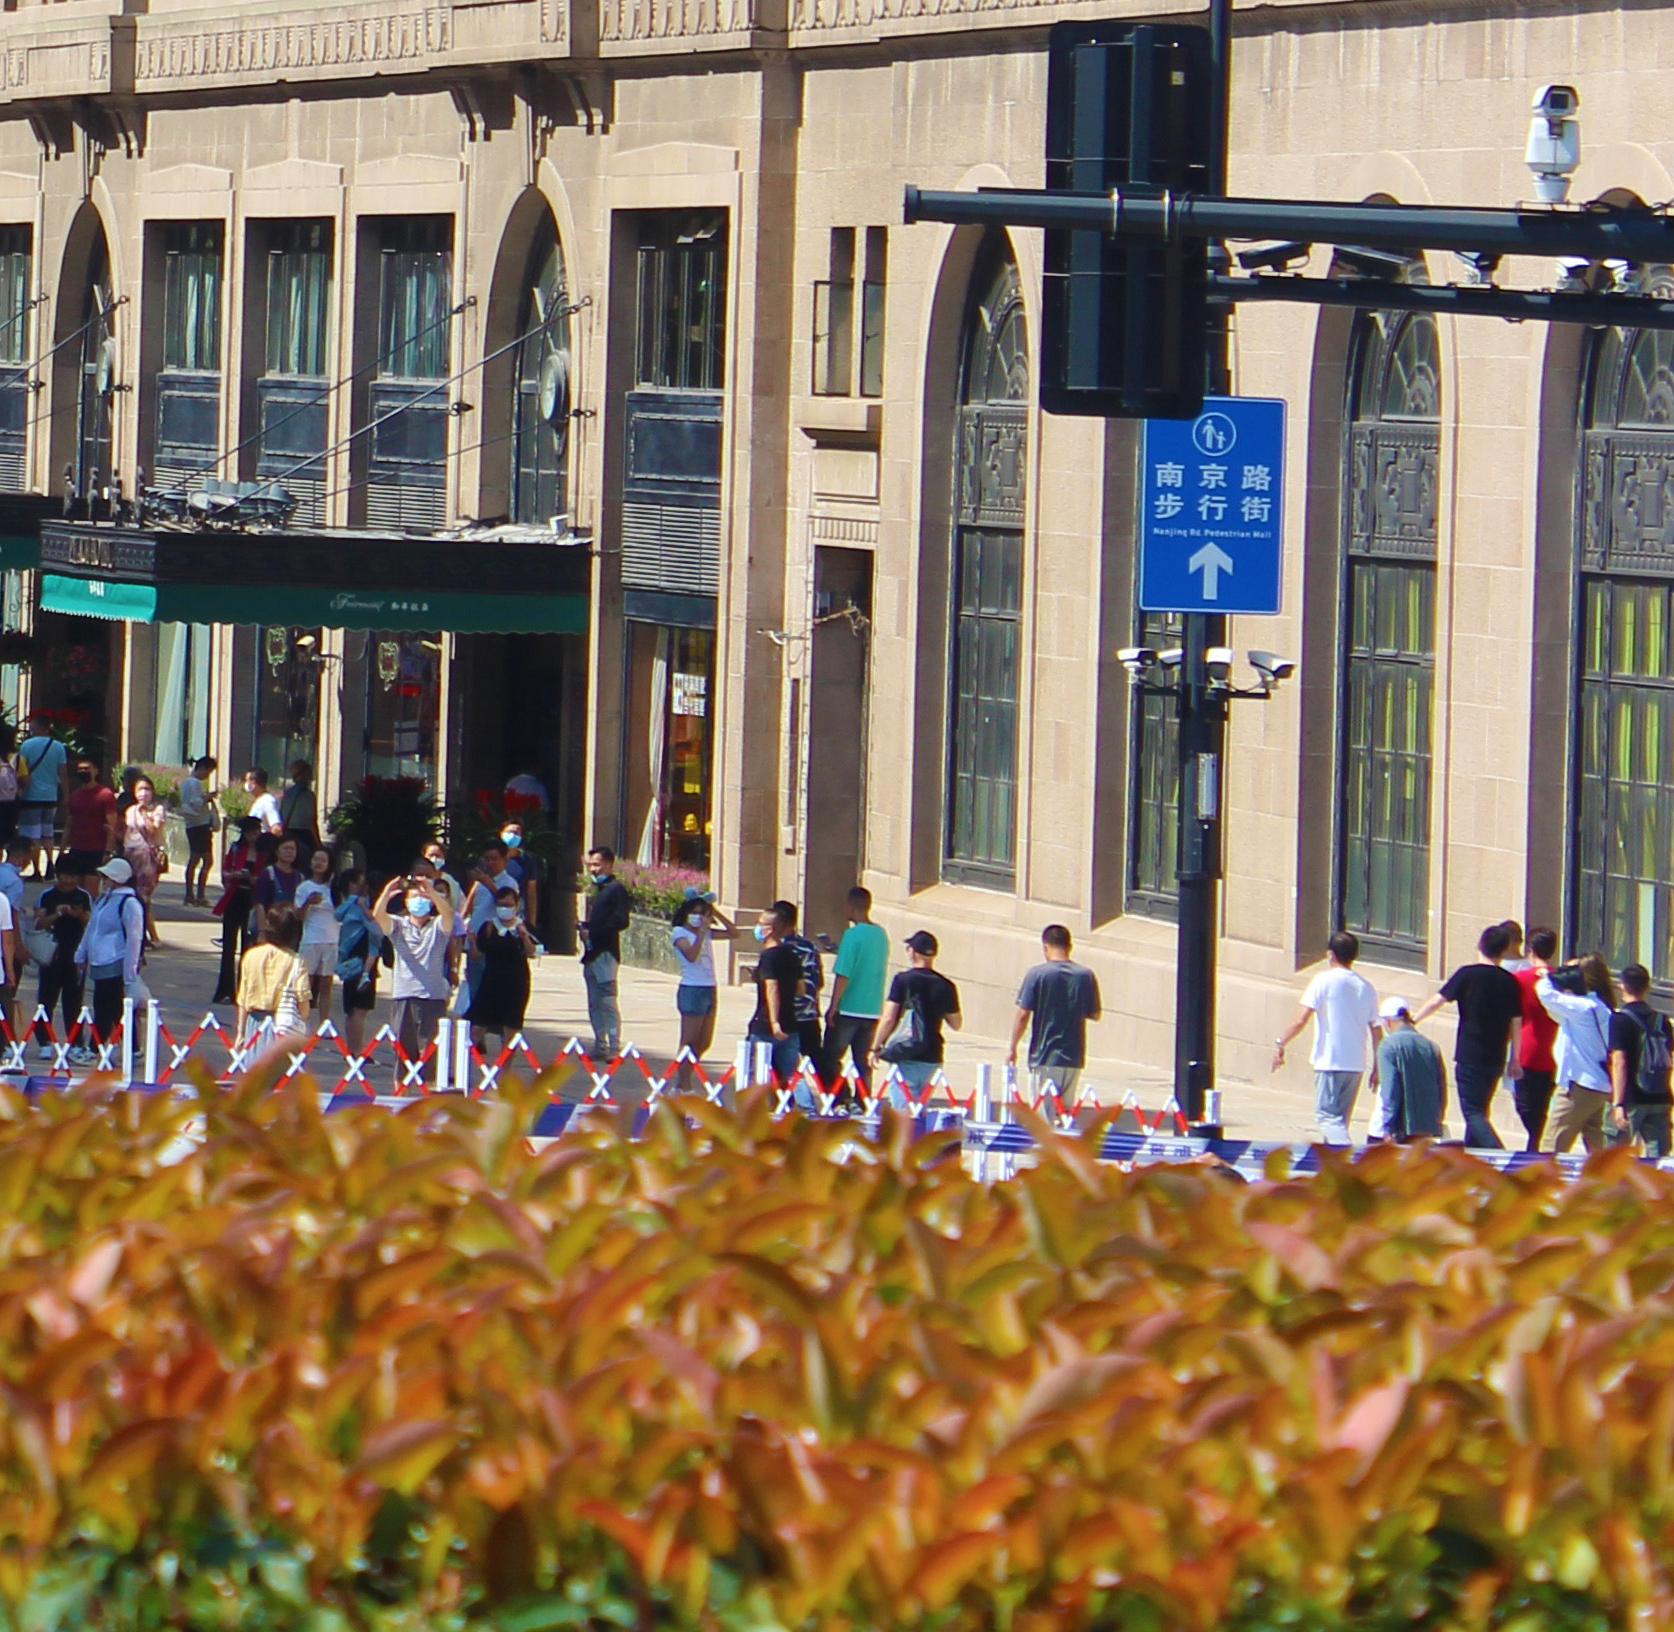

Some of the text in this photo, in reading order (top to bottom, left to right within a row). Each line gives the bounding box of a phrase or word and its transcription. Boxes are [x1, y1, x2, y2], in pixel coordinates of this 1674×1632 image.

[1155, 461, 1272, 491] 南京路
[1154, 493, 1272, 522] 步行街
[1153, 528, 1188, 538] Nanjing
[1204, 529, 1251, 538] Pedestrian
[1253, 531, 1272, 539] Mall
